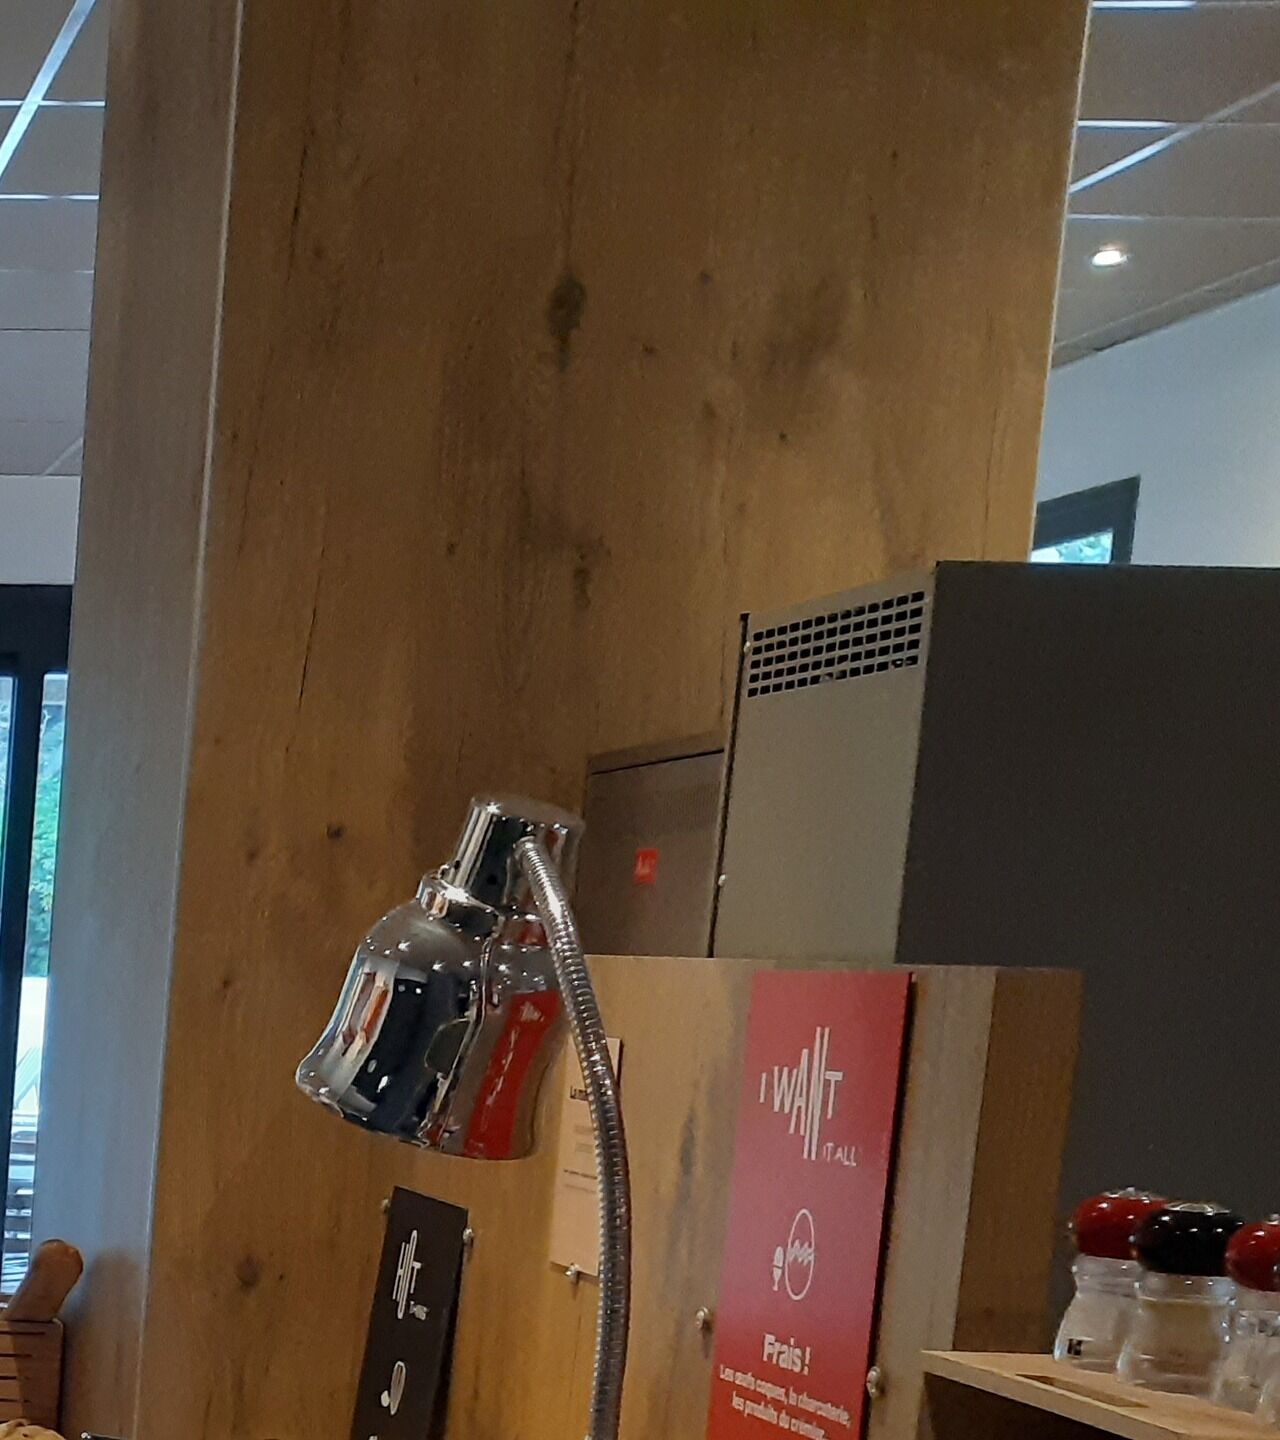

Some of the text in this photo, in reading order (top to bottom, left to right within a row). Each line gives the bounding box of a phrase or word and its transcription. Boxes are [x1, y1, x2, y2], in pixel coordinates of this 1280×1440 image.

[772, 1025, 843, 1161] WANT
[762, 1332, 802, 1373] Frais
[744, 1399, 779, 1426] produits
[778, 1408, 791, 1429] du
